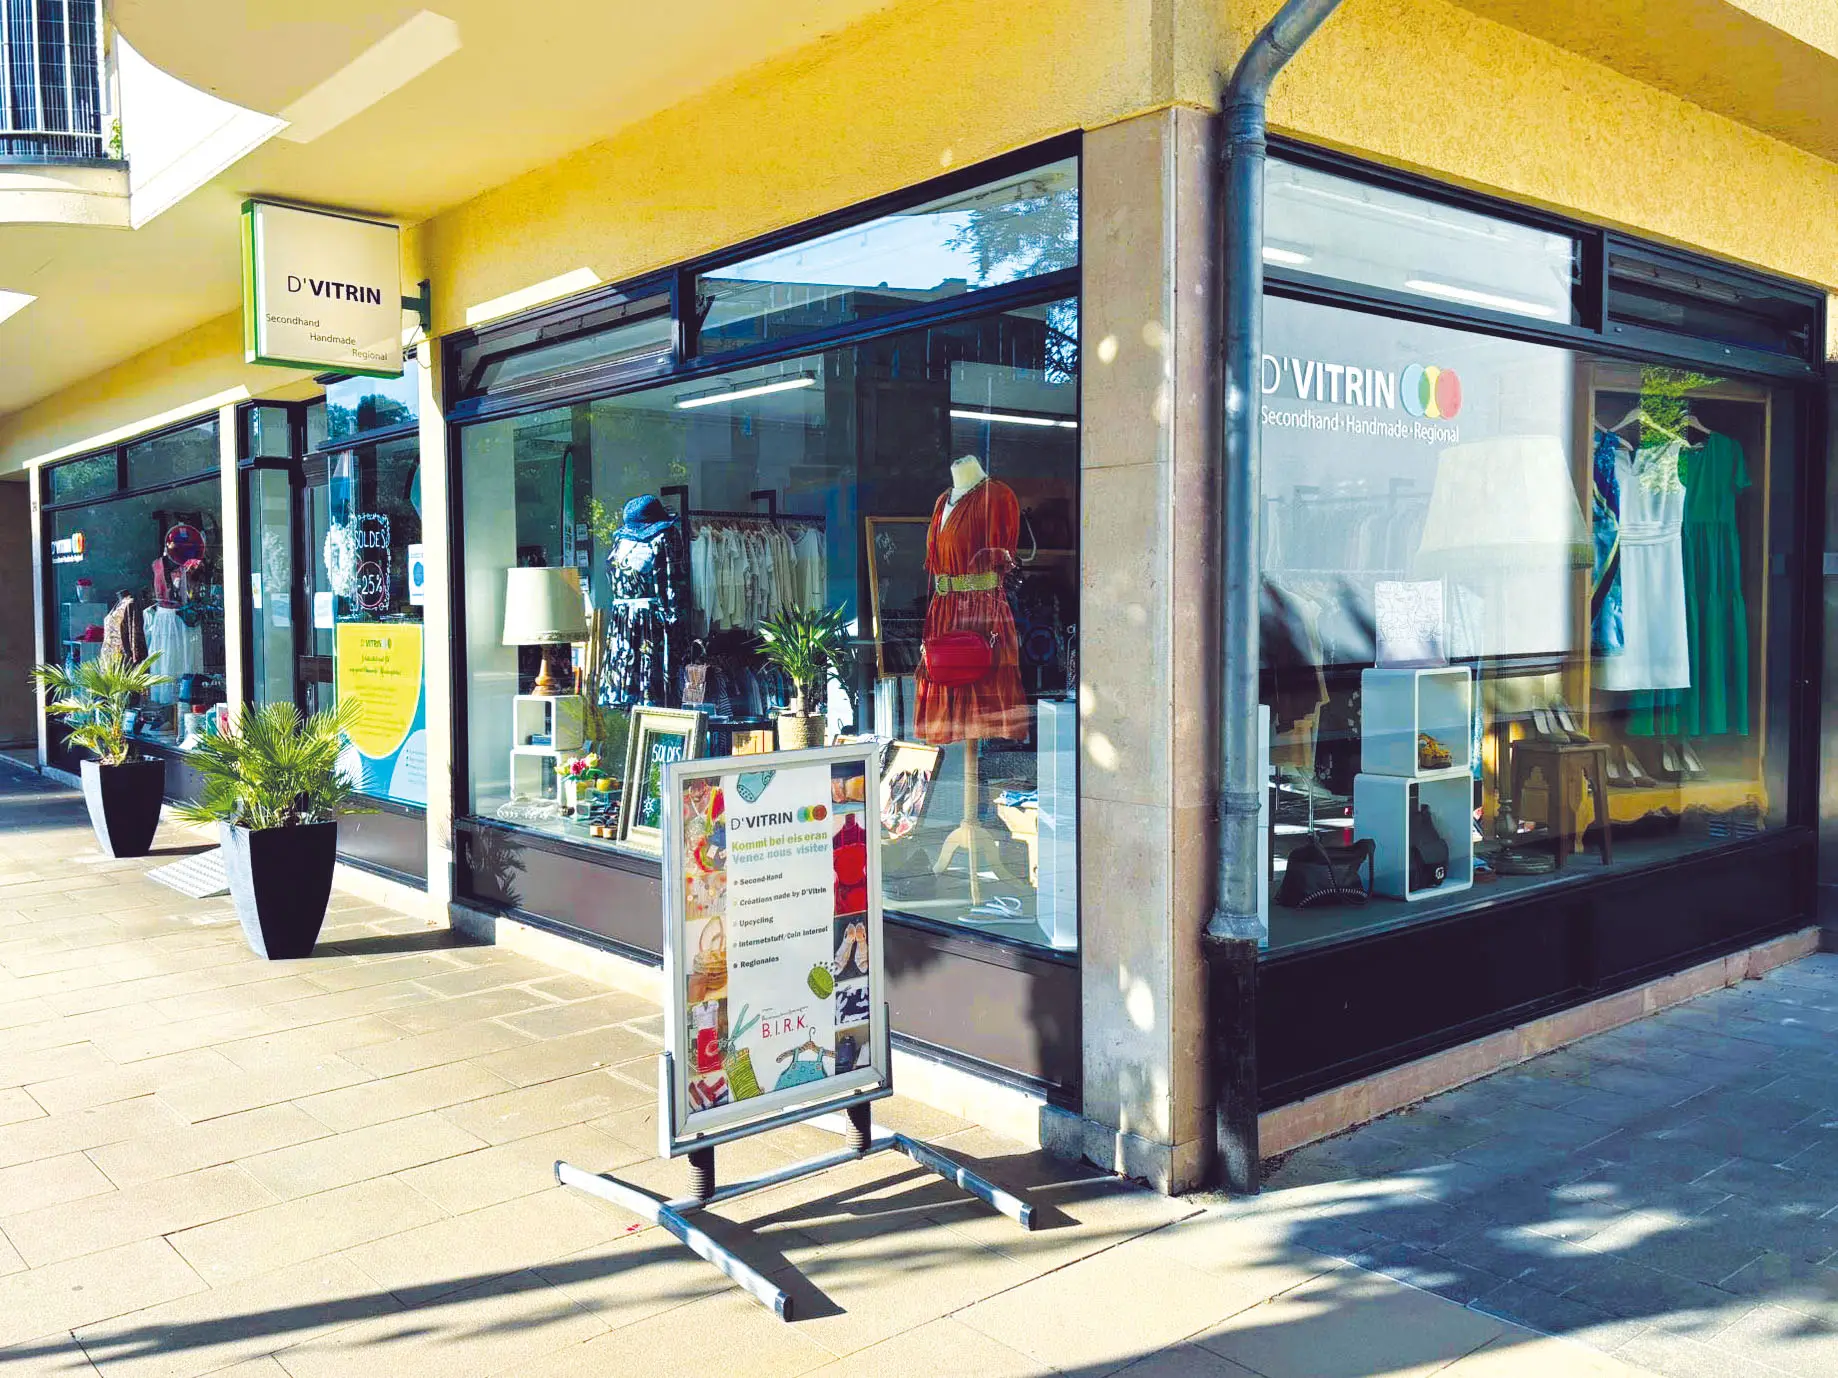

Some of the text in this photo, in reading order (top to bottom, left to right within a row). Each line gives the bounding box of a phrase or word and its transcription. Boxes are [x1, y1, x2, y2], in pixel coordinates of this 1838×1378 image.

[287, 275, 381, 305] D'VITRIN
[265, 313, 320, 328] Secondhand
[309, 331, 357, 346] Handmade
[352, 348, 388, 361] Regional
[1261, 353, 1396, 410] D'VITRIN
[1261, 404, 1460, 445] Secondhand Handmade Regional
[355, 528, 386, 550] SOLDES
[357, 573, 383, 596] -25%
[731, 811, 793, 831] D'VITRIN
[732, 831, 828, 853] Kommt bei eis eran
[732, 842, 829, 865] Venez nous visiter
[773, 892, 791, 900] made
[792, 890, 800, 898] by
[739, 915, 774, 928] Upcycling
[802, 925, 828, 937] Internet
[740, 955, 780, 969] Regionales
